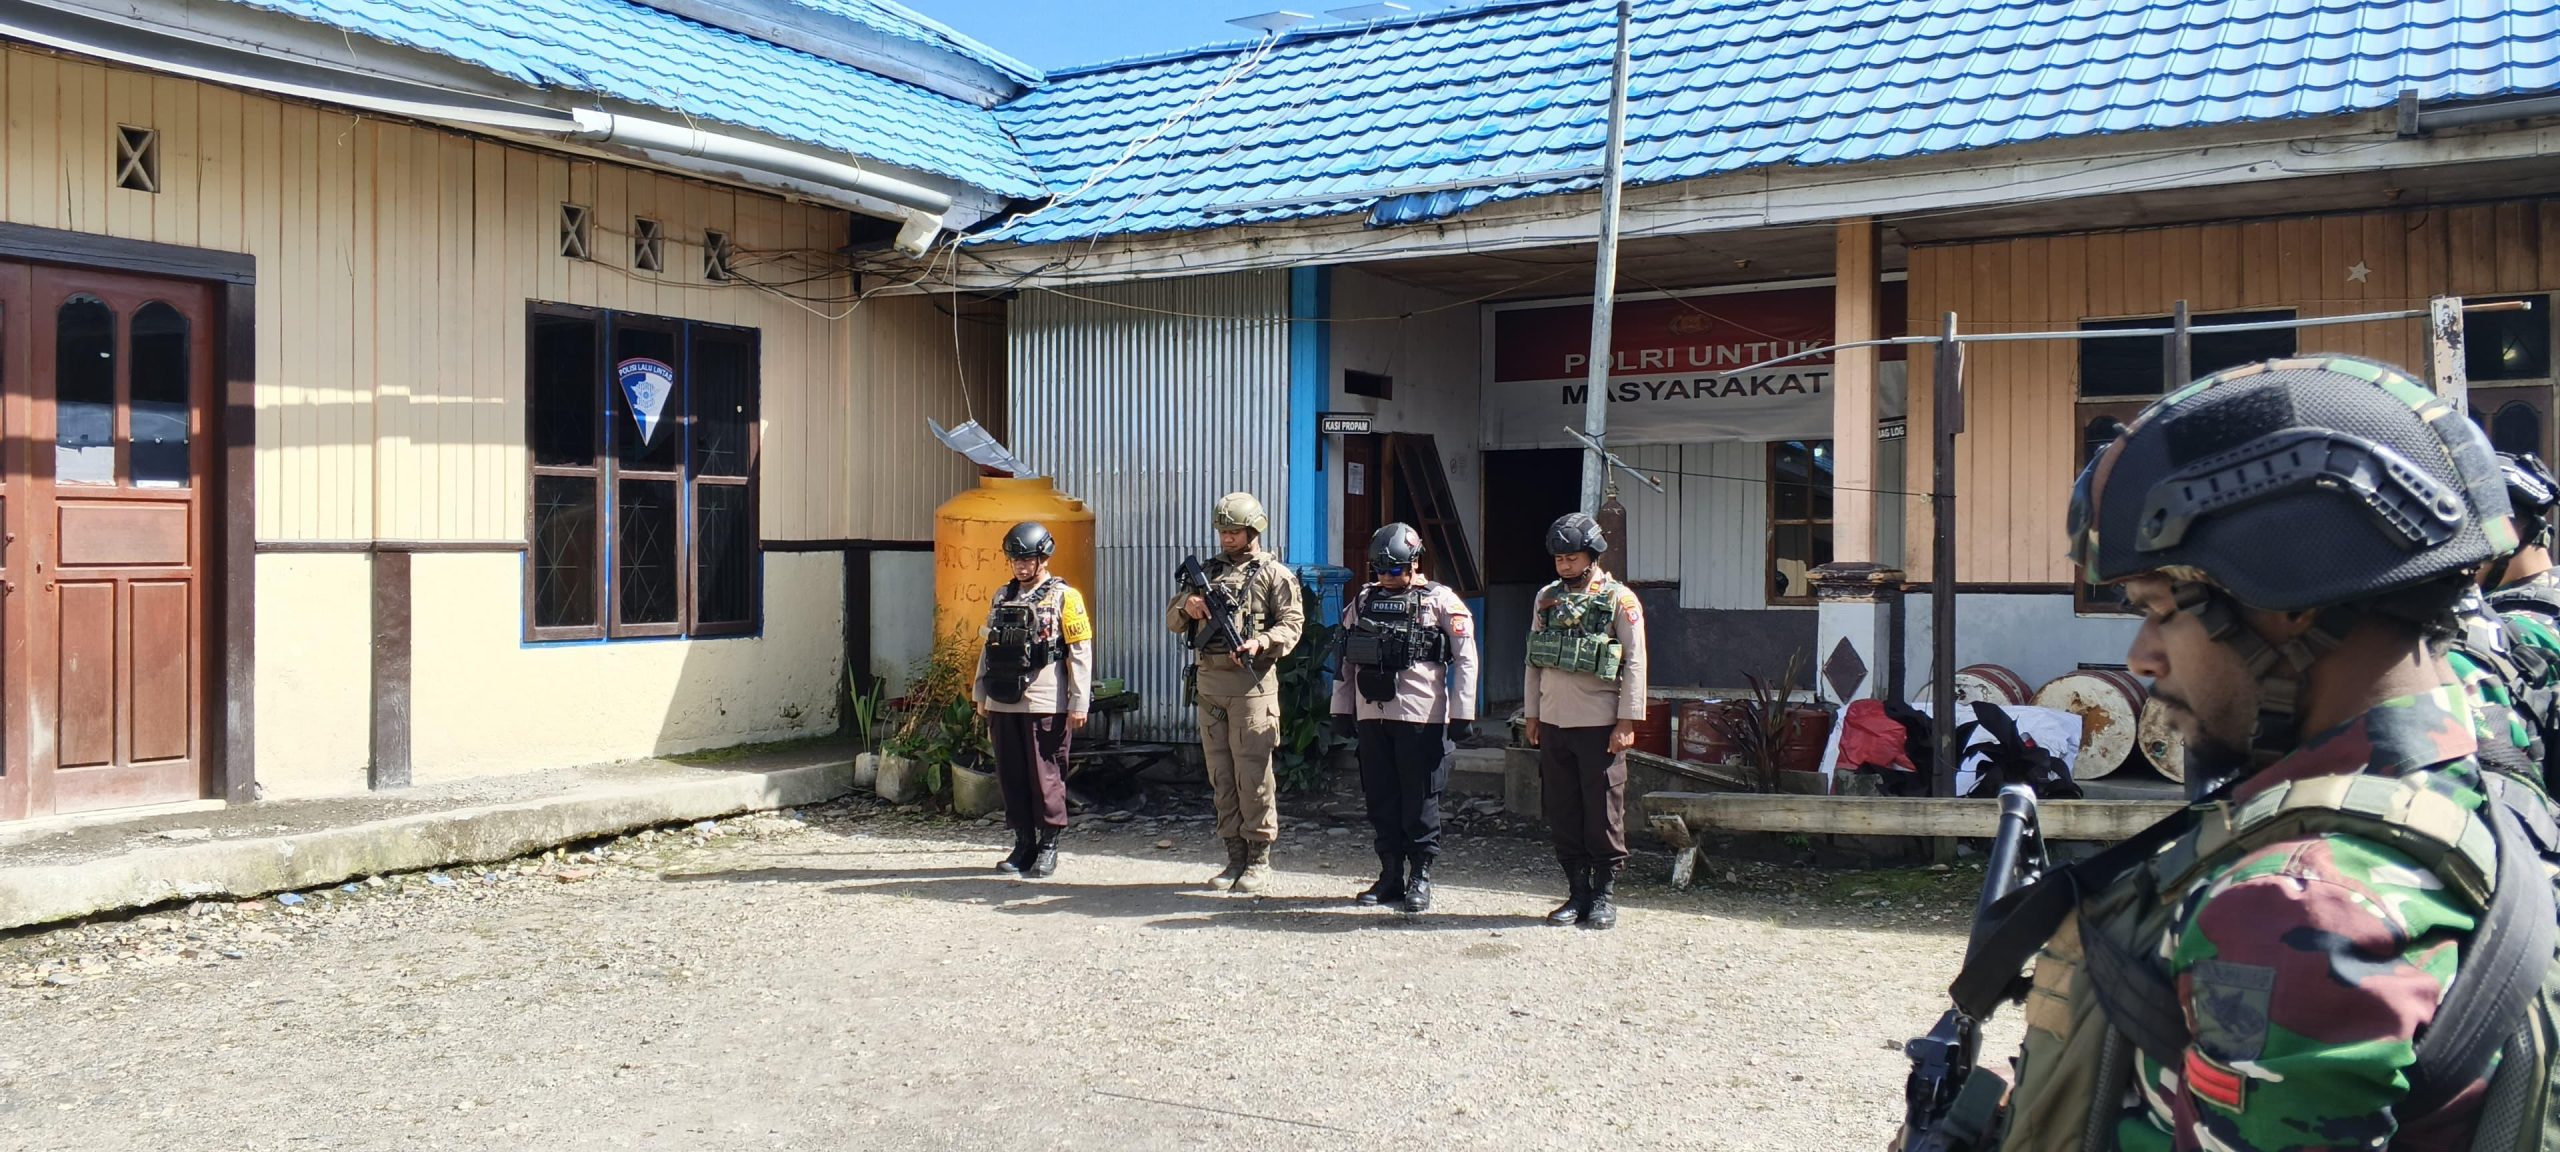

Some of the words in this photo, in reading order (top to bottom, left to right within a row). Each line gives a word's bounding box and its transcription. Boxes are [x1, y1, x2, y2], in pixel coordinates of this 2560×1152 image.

[1565, 347, 1674, 374] PLRI
[1688, 339, 1828, 366] UNTUK
[619, 364, 636, 376] POLISI
[1325, 421, 1341, 431] KASI
[1342, 421, 1368, 431] PROPAM
